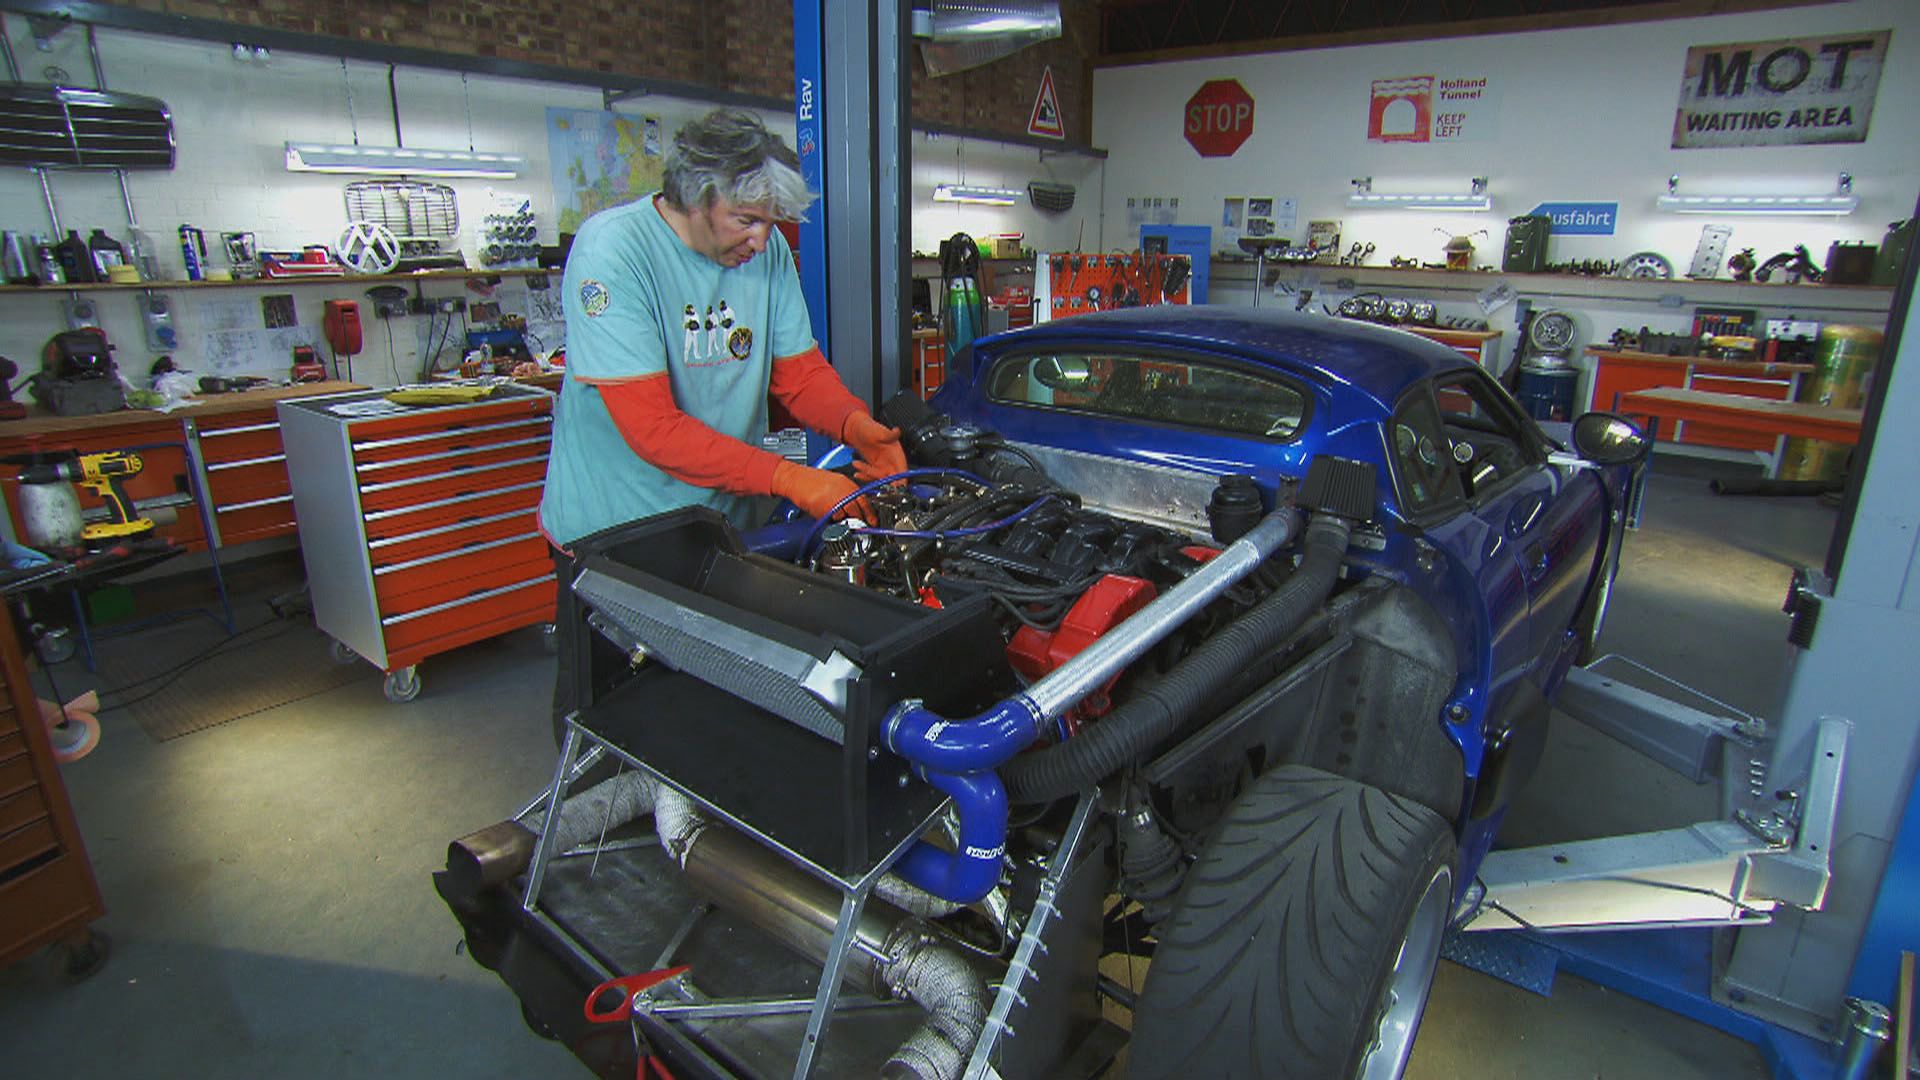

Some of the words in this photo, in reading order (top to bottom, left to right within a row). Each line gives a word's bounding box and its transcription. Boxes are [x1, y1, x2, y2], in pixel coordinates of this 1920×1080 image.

[1696, 39, 1874, 97] MOT
[1440, 77, 1487, 89] Holland
[800, 77, 813, 121] Rav
[1440, 90, 1481, 101] Tunnel
[1188, 103, 1251, 133] STOP
[1436, 113, 1466, 126] KEEP
[1686, 111, 1781, 132] WAITING
[1784, 105, 1853, 129] AREA
[1435, 126, 1462, 138] LEFT
